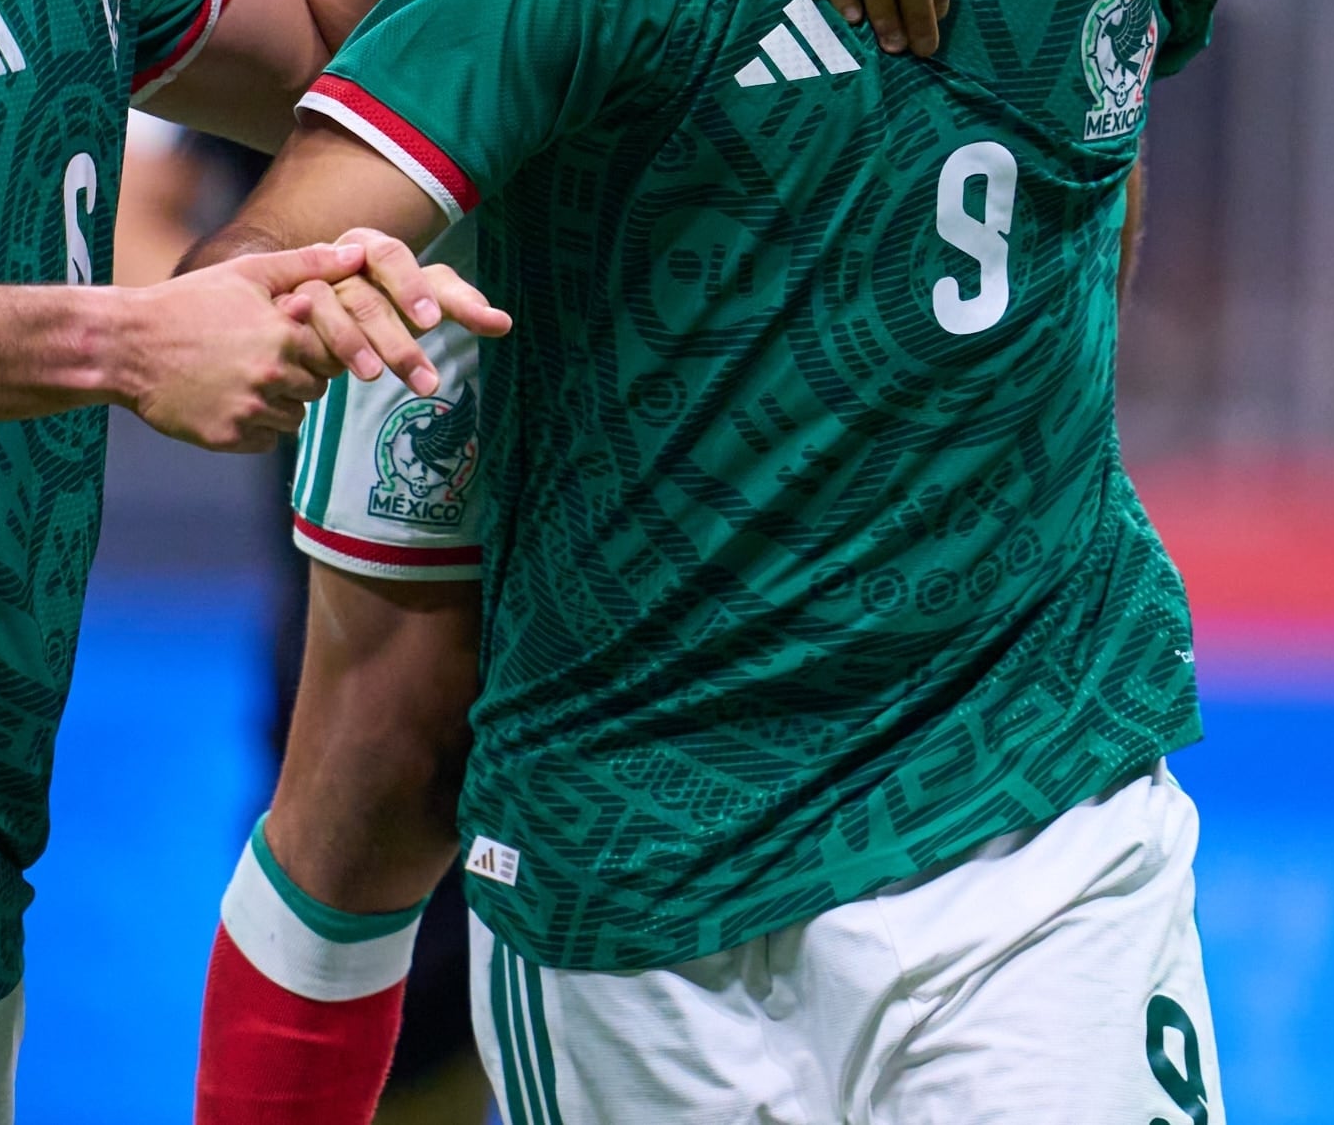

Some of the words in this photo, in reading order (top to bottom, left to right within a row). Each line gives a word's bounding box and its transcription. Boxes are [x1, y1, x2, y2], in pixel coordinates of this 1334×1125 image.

[1086, 106, 1143, 136] MÉXICO
[932, 141, 1018, 334] 9
[374, 492, 459, 520] MÉXICO
[1146, 994, 1208, 1125] 9
